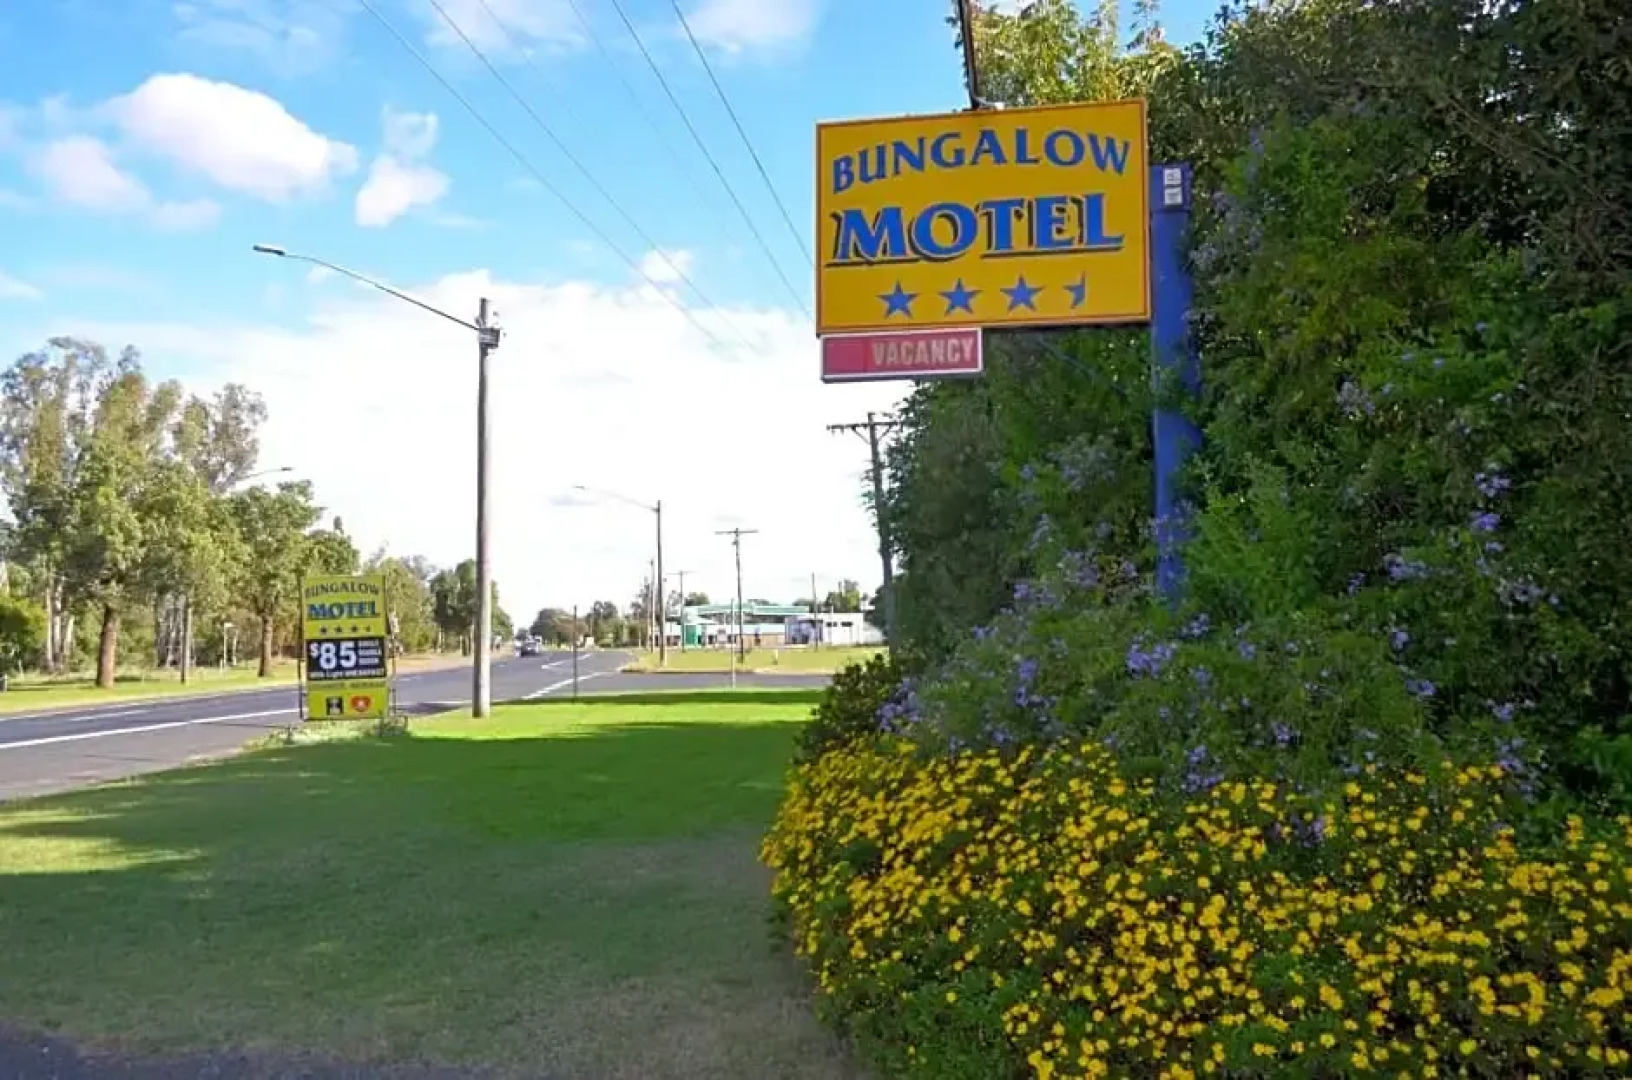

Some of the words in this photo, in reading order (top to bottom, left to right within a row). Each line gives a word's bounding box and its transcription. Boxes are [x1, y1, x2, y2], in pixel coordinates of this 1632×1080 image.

[832, 128, 1130, 194] BUNGALOW
[827, 193, 1124, 265] MOTEL
[871, 336, 975, 367] VACANCY
[307, 601, 378, 619] MOTEL
[309, 641, 357, 669] $85
